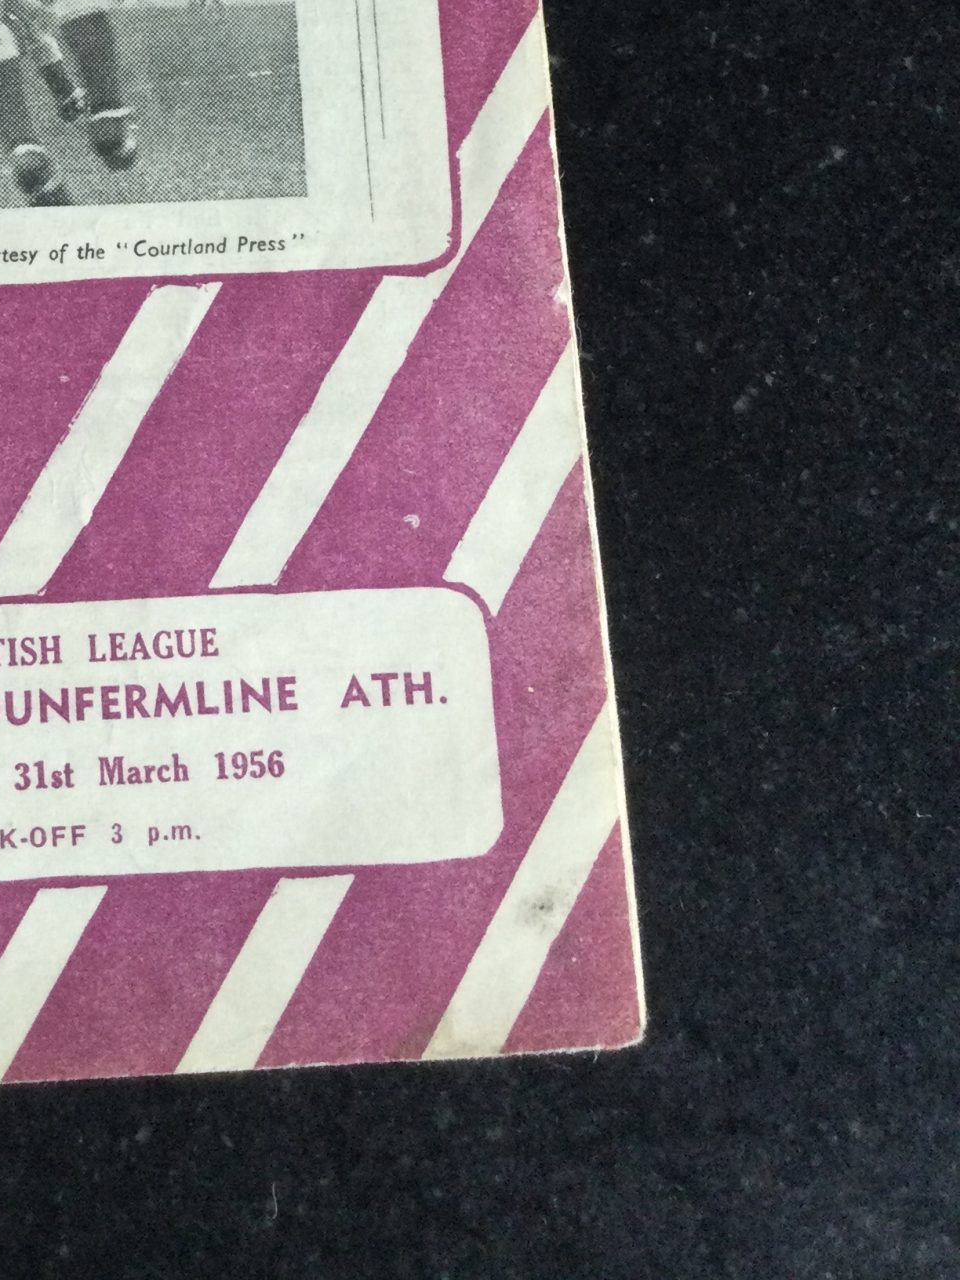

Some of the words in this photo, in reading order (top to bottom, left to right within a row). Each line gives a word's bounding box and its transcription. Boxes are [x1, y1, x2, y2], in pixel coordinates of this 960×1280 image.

[48, 243, 70, 265] of
[76, 242, 106, 260] the
[87, 627, 220, 663] LEAGUE
[340, 671, 448, 709] ATH.
[14, 760, 75, 791] 31st
[97, 752, 190, 787] March
[214, 749, 285, 780] 1956
[111, 822, 124, 845] 3
[148, 824, 201, 847] p.m.
